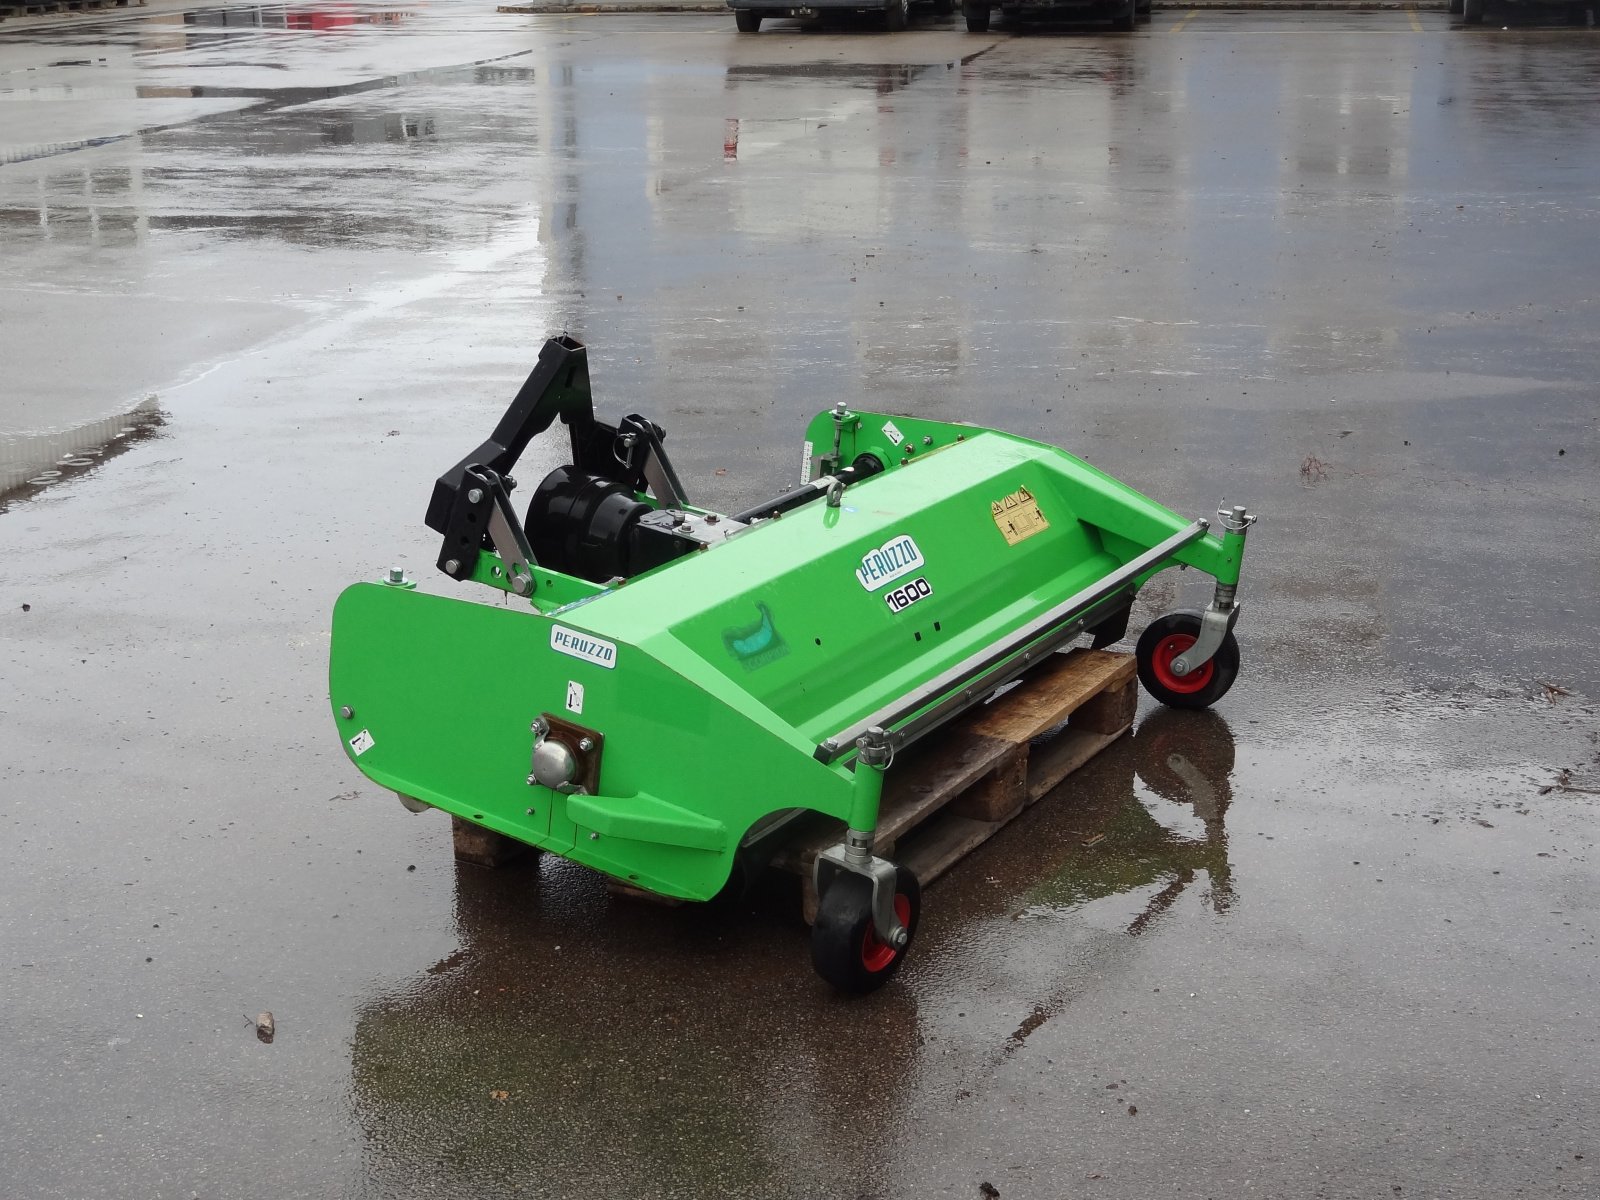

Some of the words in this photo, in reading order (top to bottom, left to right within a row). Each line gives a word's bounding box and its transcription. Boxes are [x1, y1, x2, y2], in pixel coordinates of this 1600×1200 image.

[861, 539, 918, 584] PERUZZO
[886, 578, 931, 610] 1600
[554, 631, 613, 661] PERUZZO
